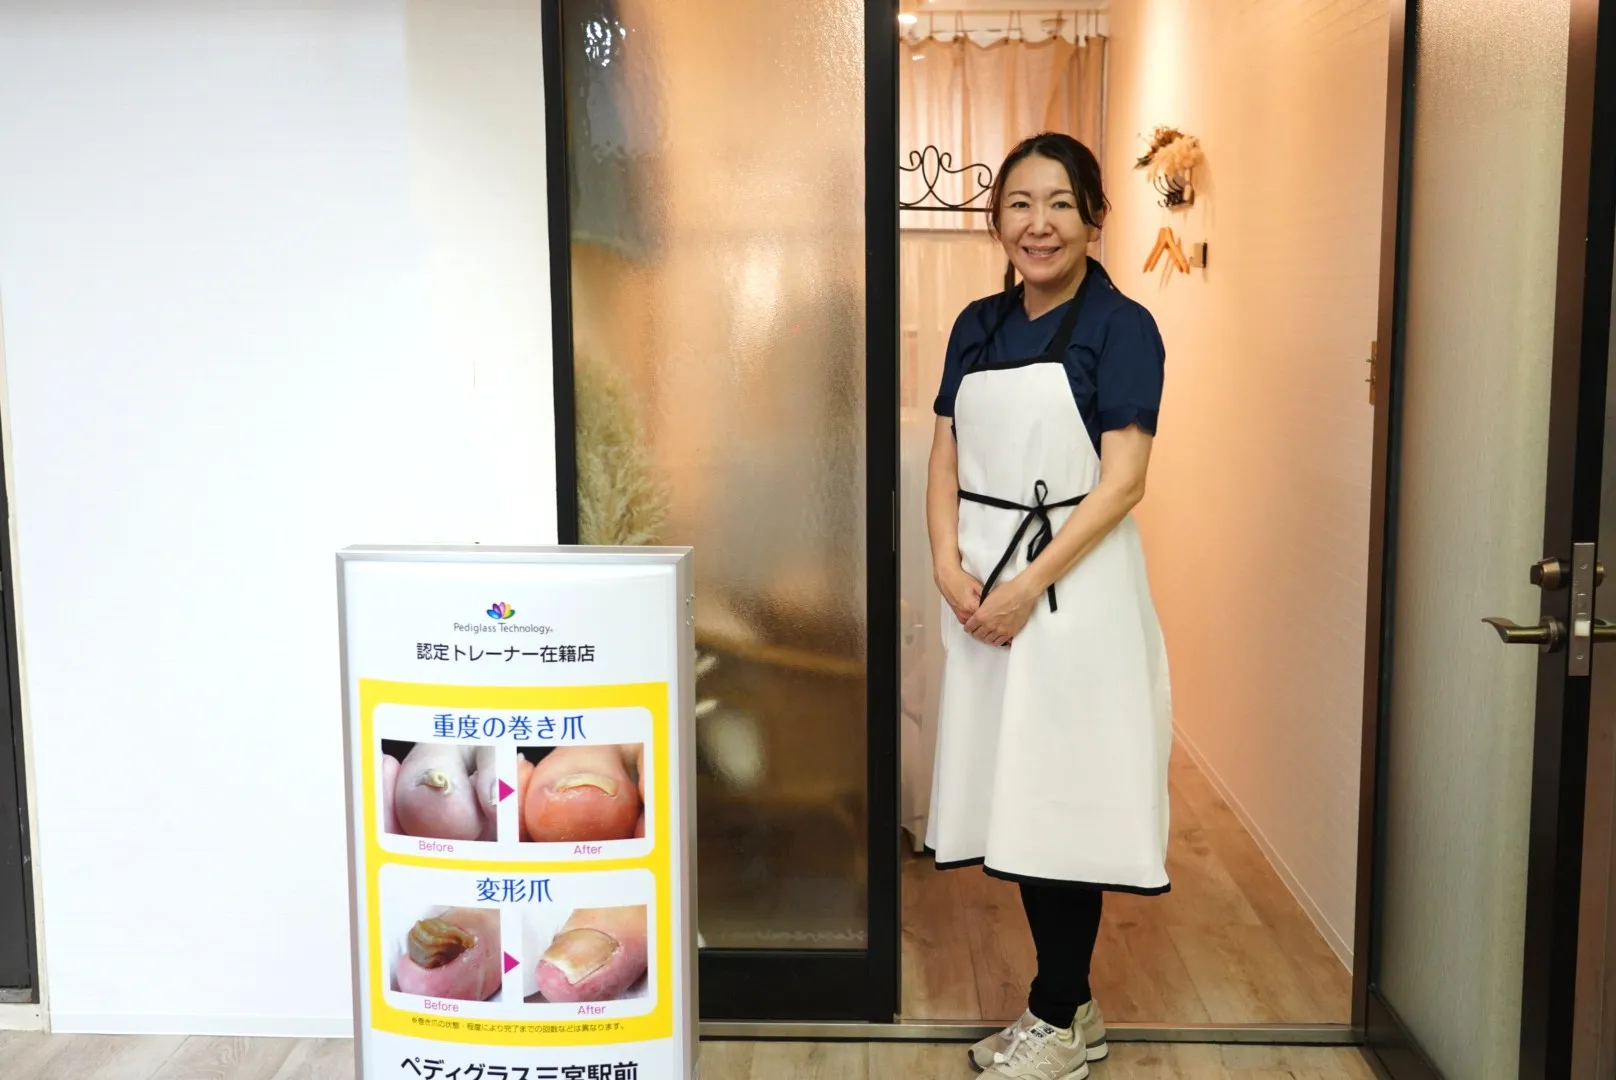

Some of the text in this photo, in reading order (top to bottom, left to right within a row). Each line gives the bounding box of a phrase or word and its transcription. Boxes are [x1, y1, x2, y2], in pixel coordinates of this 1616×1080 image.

[453, 622, 497, 635] Pediglass
[416, 642, 596, 664] 認定トレーナー在籍店
[433, 713, 587, 741] 重度の巻き爪
[418, 839, 455, 853] Before
[574, 844, 603, 855] After
[476, 877, 553, 903] 変形爪
[424, 999, 460, 1012] Before
[577, 1005, 607, 1015] After
